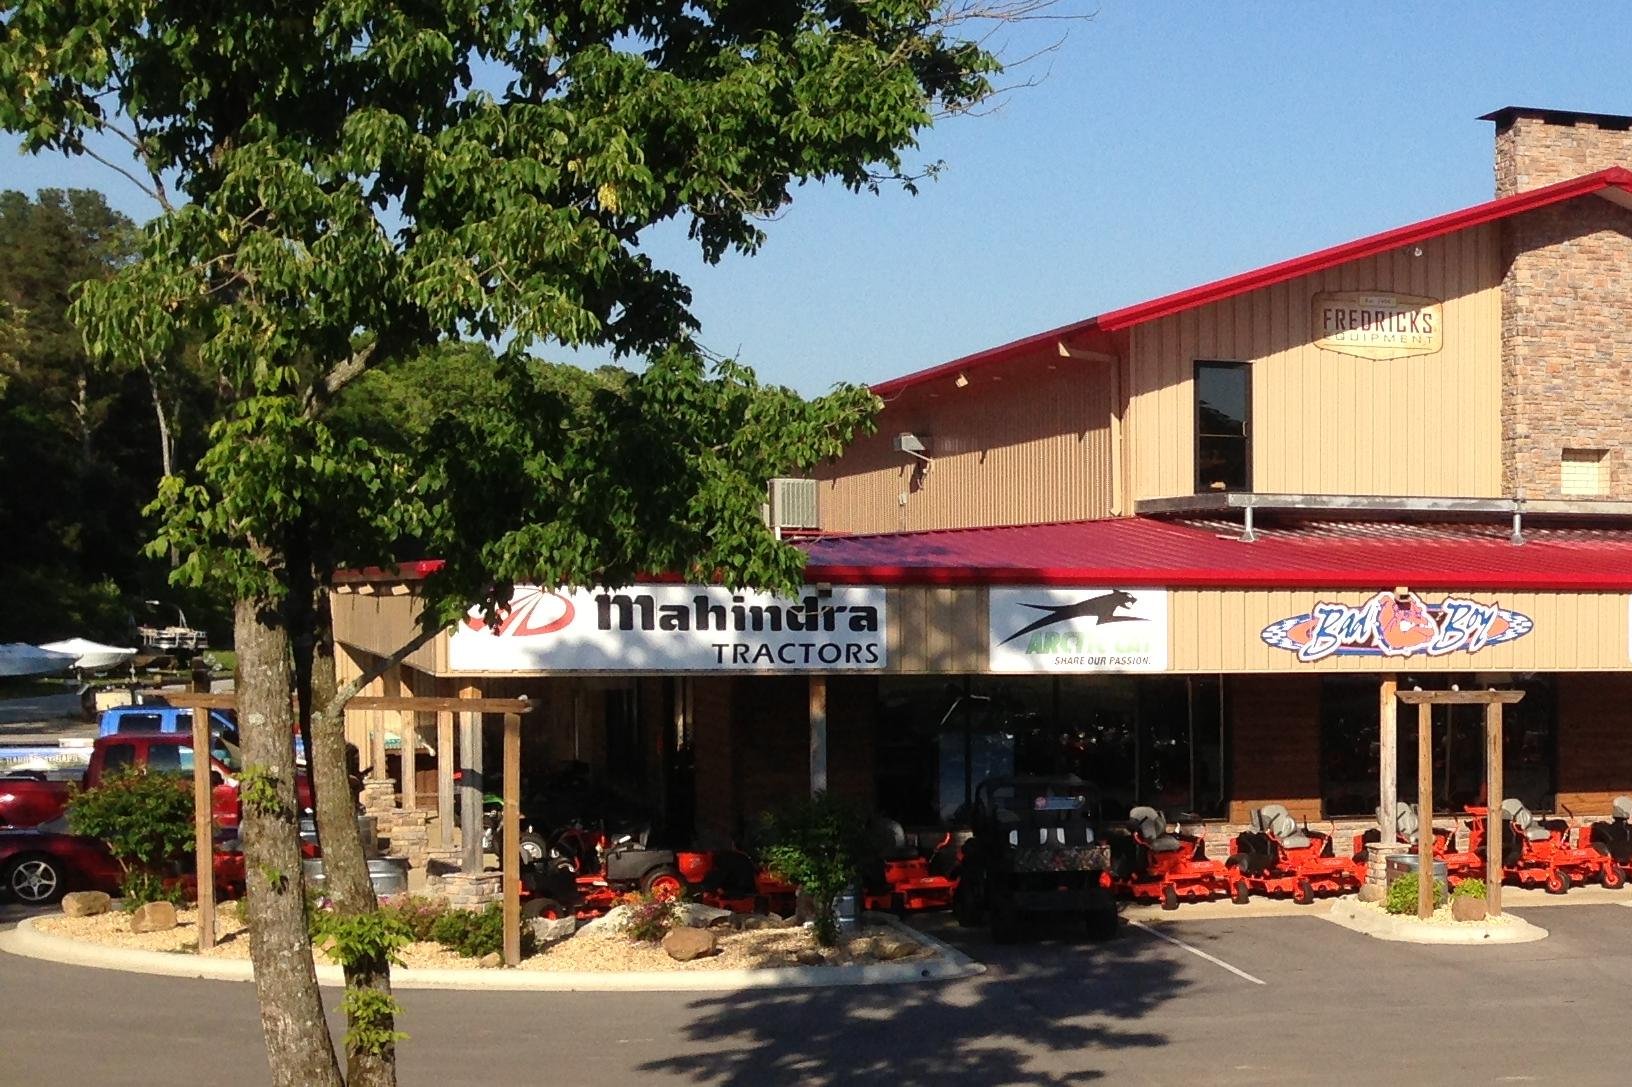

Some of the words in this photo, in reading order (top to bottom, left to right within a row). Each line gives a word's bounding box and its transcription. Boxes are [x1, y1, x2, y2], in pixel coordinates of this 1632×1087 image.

[1323, 308, 1433, 334] FREDRICKS
[1323, 332, 1433, 344] EQUIPMENT
[595, 594, 878, 632] Mahindra
[1427, 598, 1498, 657] Boy
[712, 643, 879, 664] TRACTORS
[1054, 656, 1085, 665] SHARE
[1087, 656, 1107, 665] OUR
